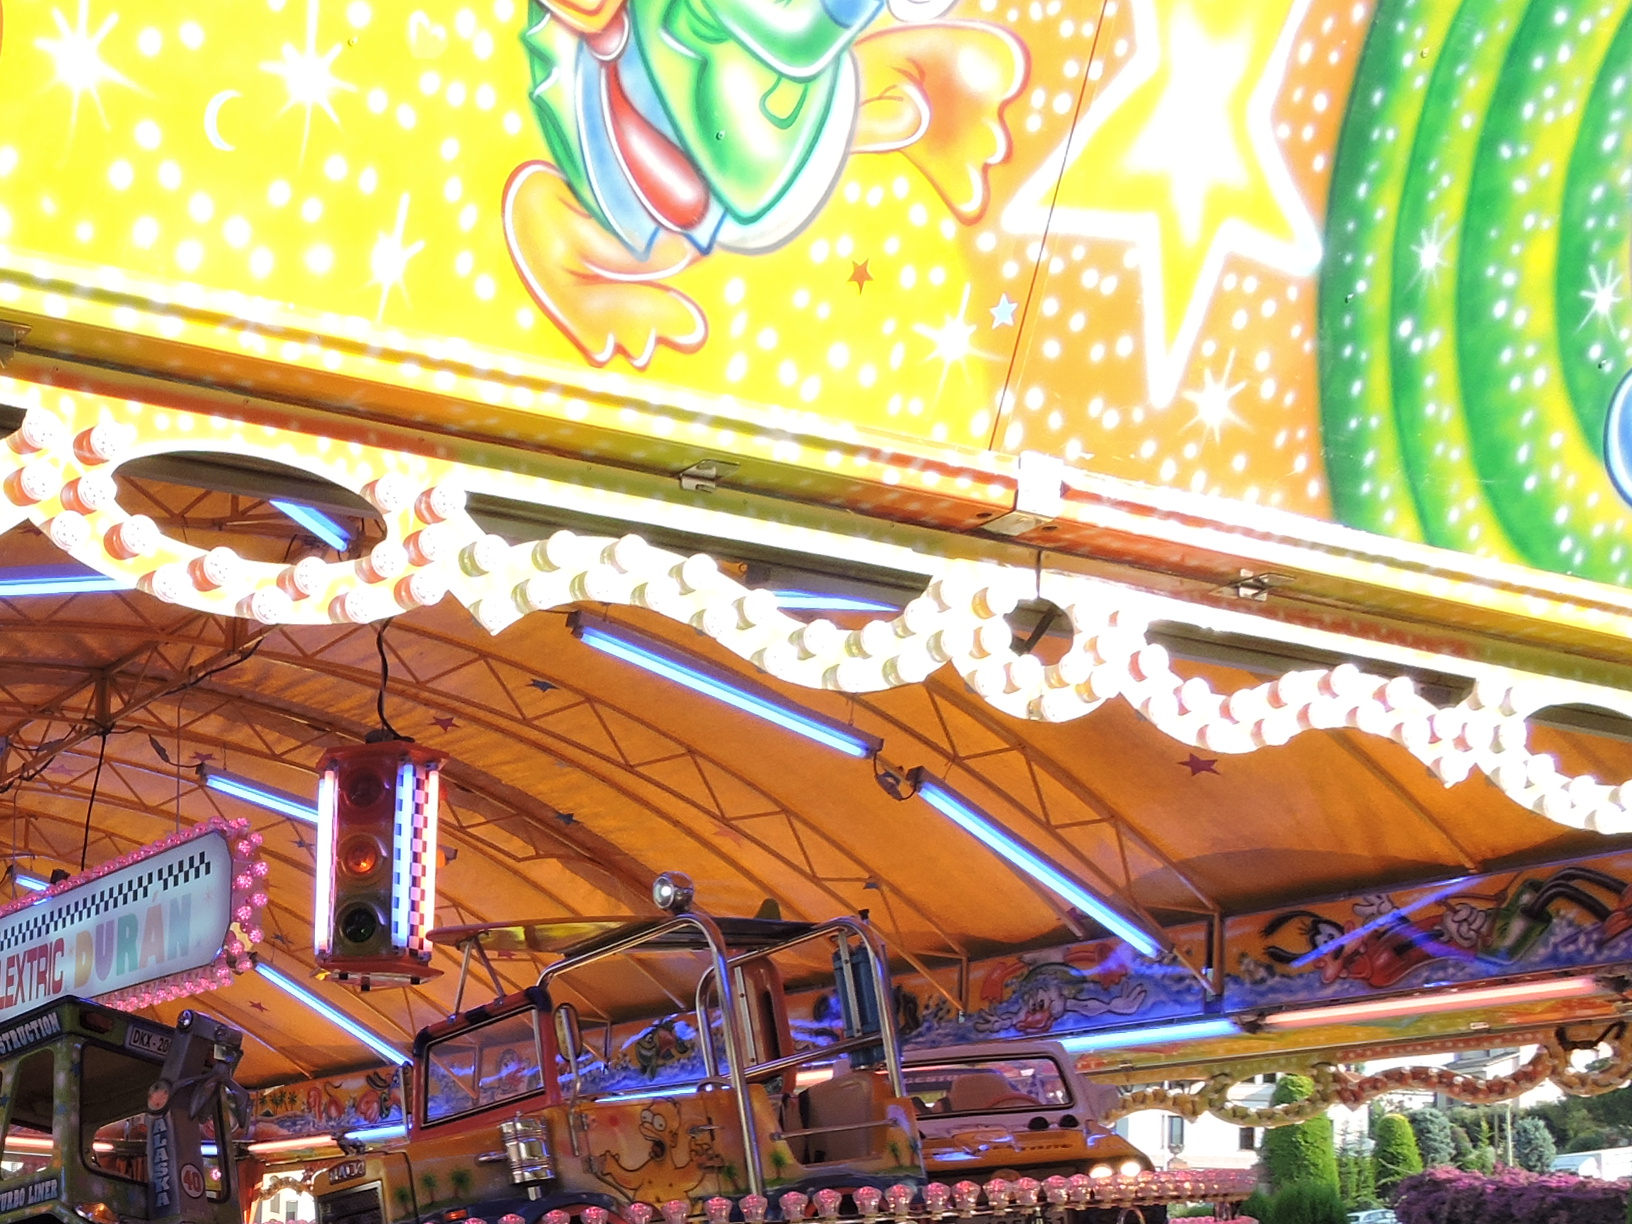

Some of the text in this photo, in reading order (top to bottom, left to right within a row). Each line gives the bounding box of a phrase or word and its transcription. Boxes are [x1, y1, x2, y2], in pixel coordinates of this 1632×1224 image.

[73, 891, 193, 990] DURÁN
[152, 1117, 170, 1208] ALASKA
[183, 1169, 200, 1192] 40
[28, 1179, 58, 1205] LINER
